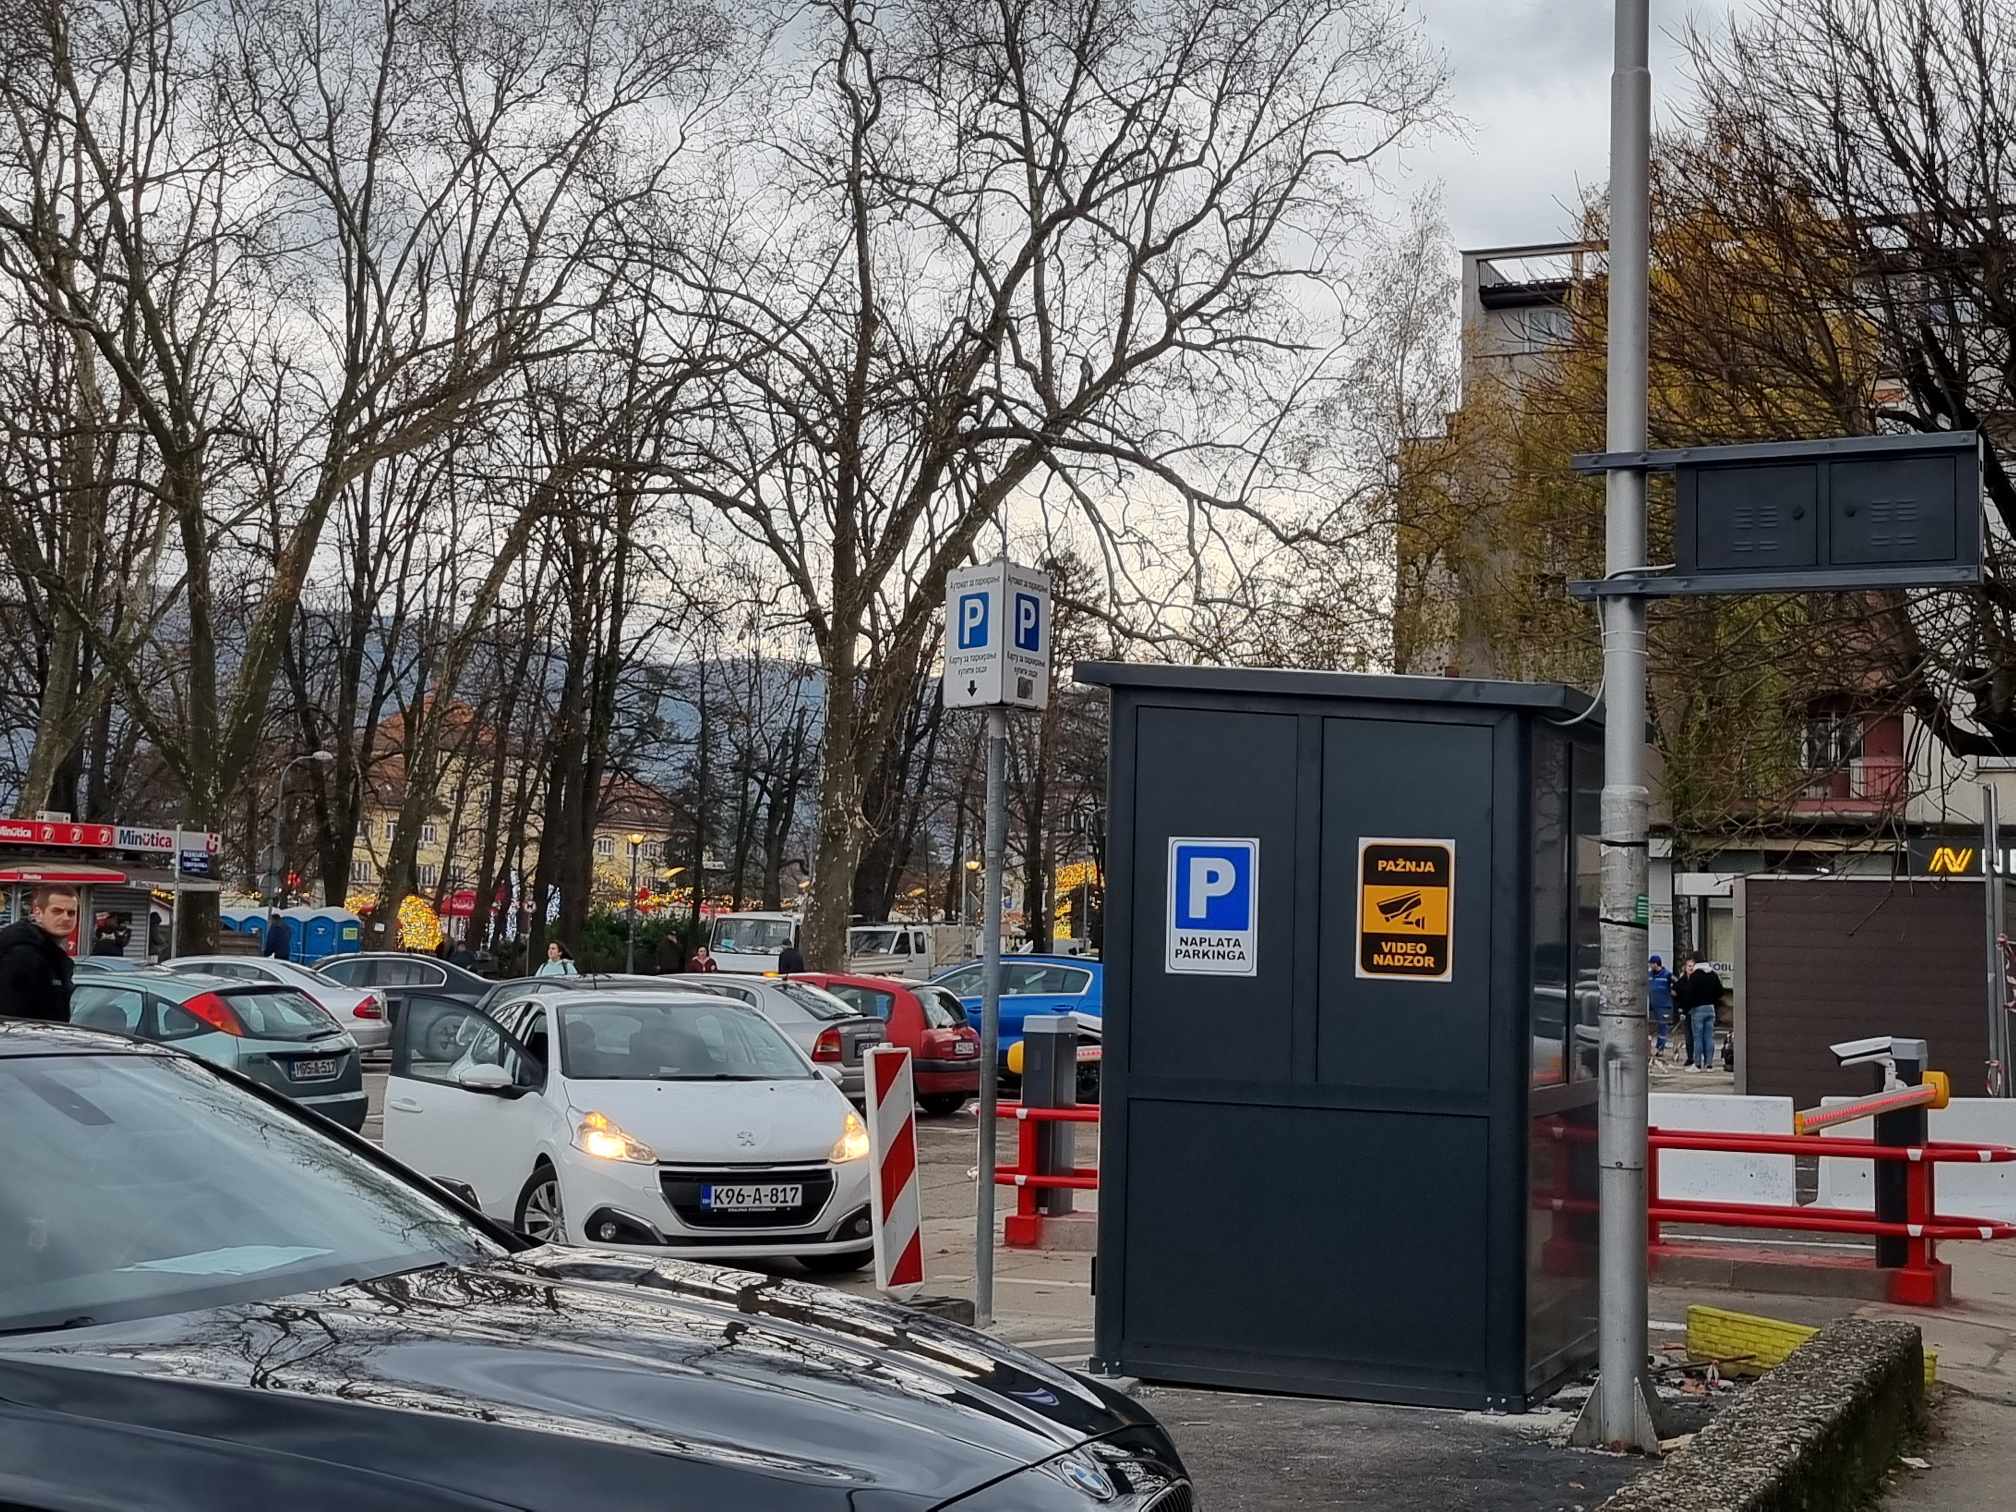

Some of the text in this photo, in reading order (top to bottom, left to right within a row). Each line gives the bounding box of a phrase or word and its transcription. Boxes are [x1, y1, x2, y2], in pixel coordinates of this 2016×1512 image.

[964, 598, 984, 645] P
[1019, 599, 1036, 645] P
[1376, 858, 1436, 874] PAŽNJA
[1188, 857, 1236, 919] P
[1178, 935, 1243, 949] NAPLATA
[1380, 941, 1428, 956] VIDEO
[1174, 948, 1247, 963] PARKINGA
[1372, 953, 1436, 969] NADZOR
[713, 1186, 800, 1206] K96-A-817
